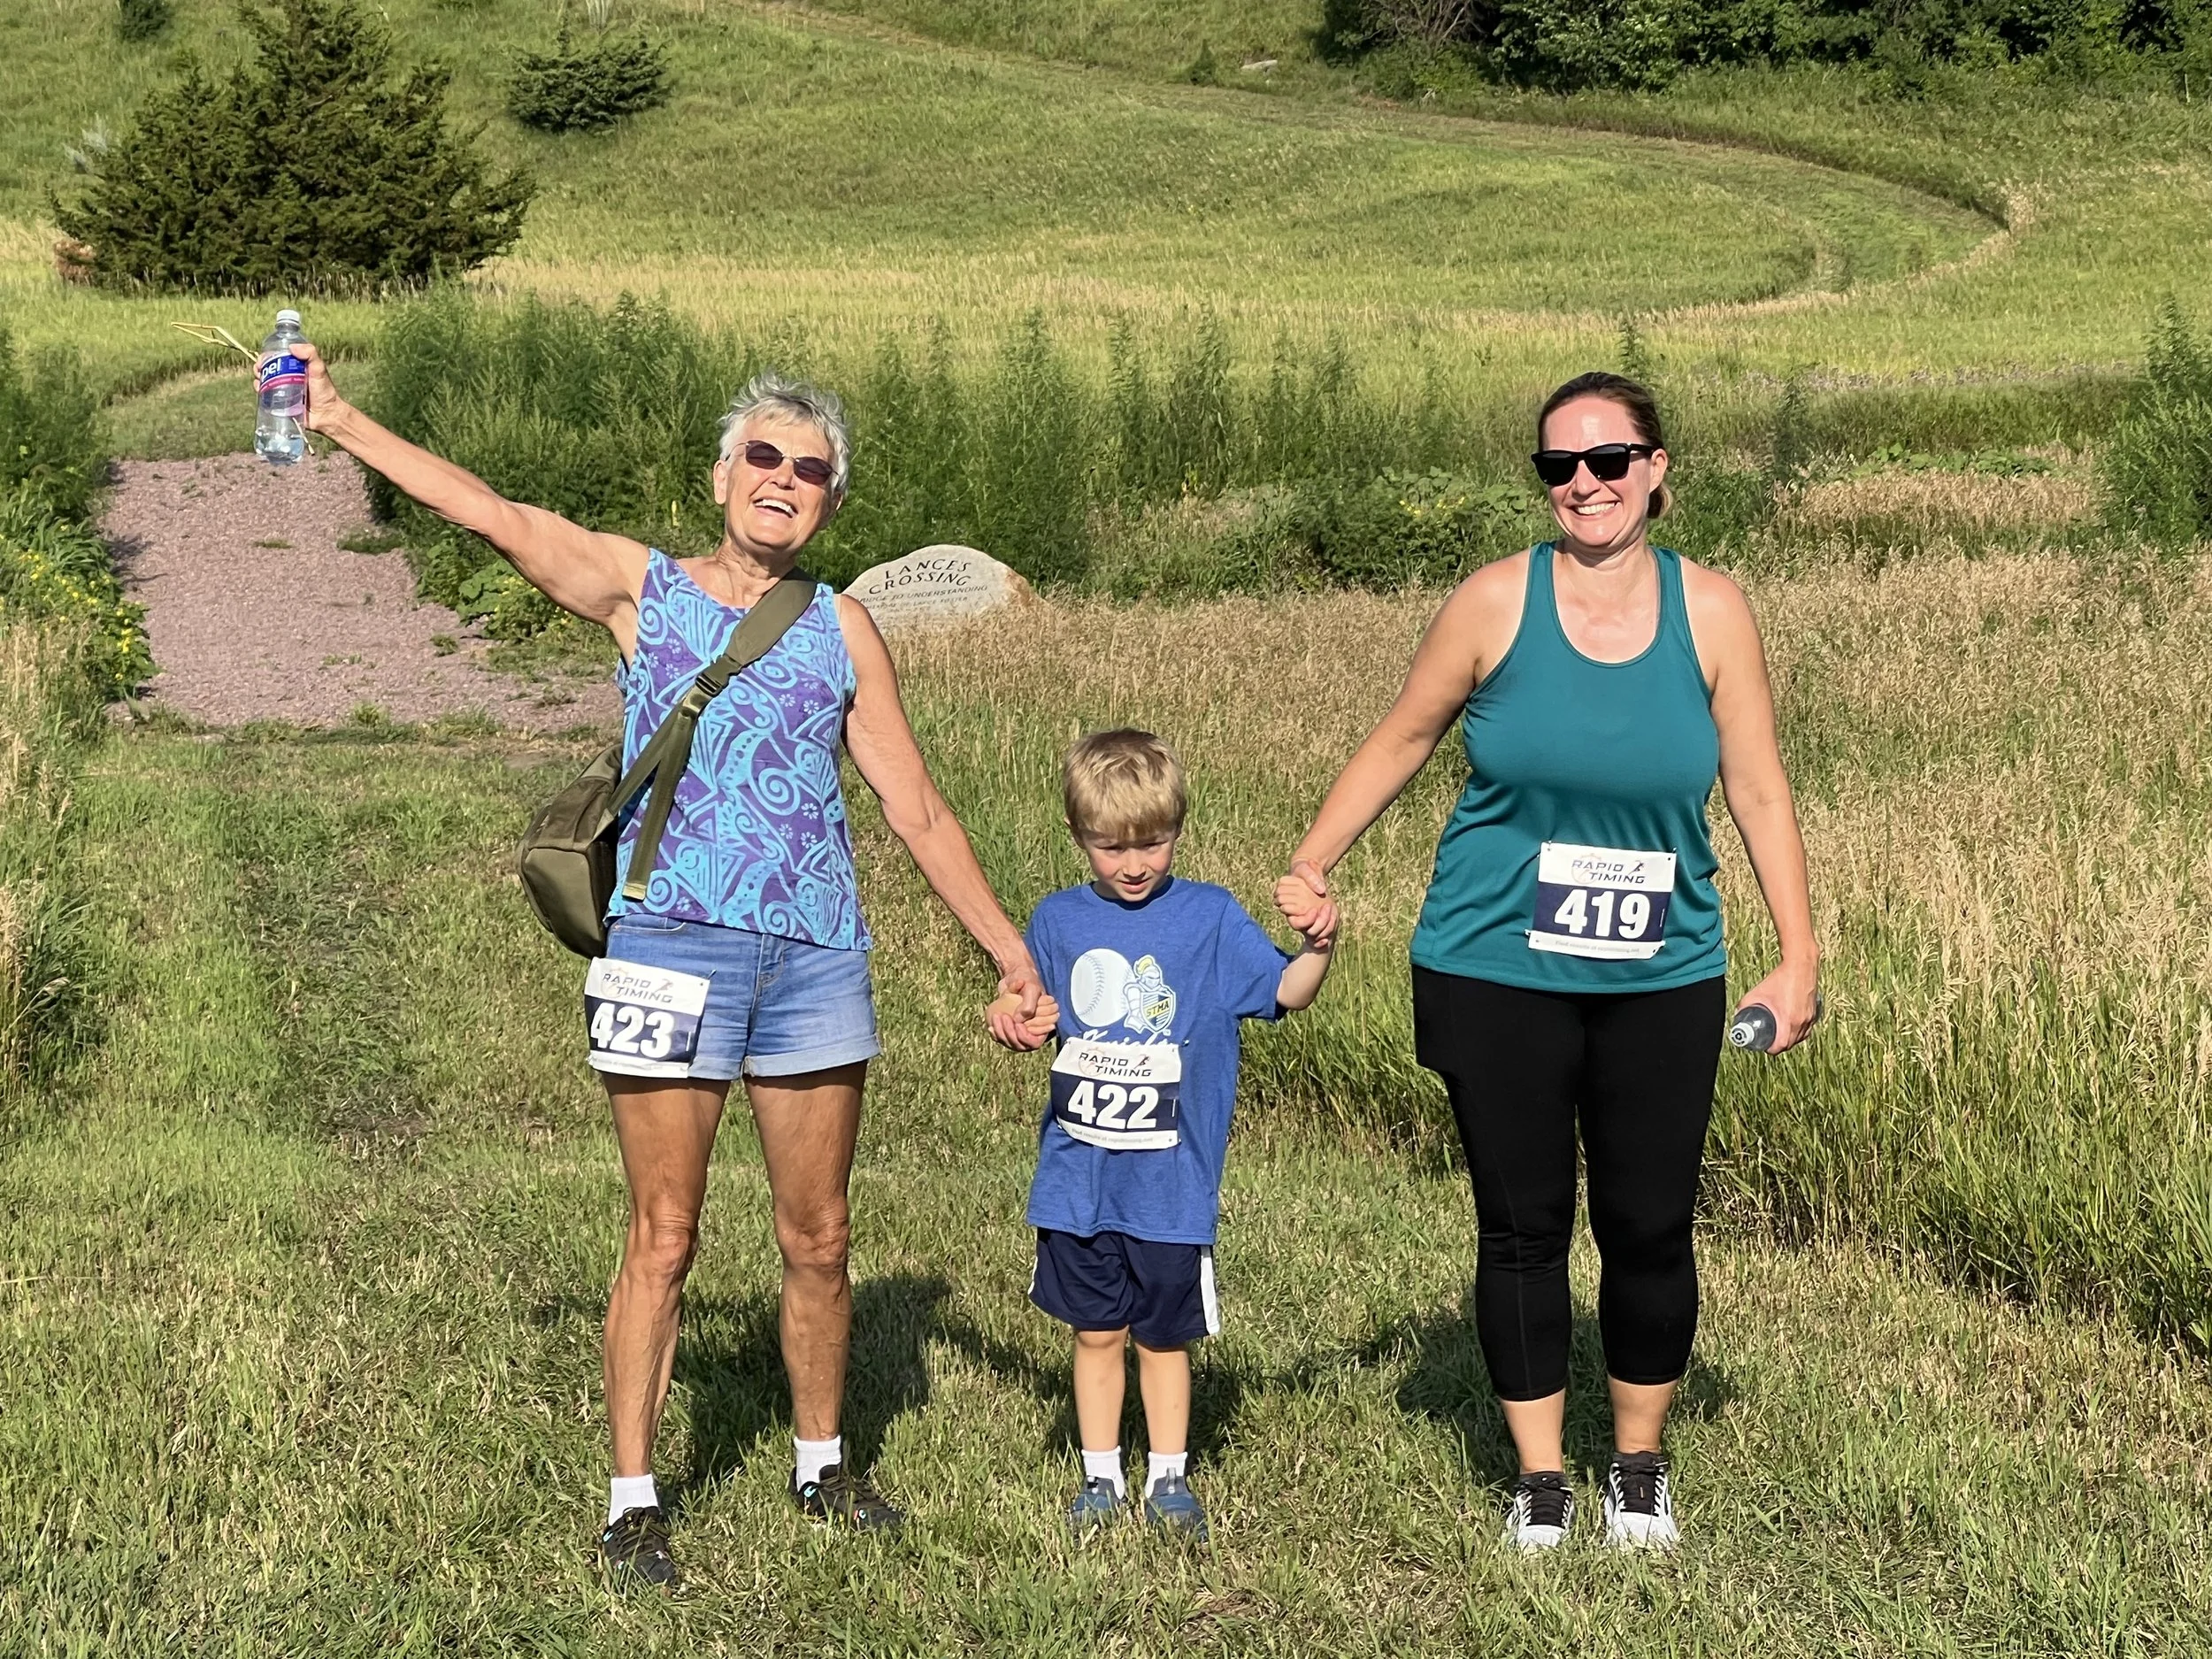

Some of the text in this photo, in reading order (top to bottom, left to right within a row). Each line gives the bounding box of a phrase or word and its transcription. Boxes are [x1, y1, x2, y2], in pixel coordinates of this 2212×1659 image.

[869, 572, 972, 595] CROSSING
[907, 586, 988, 599] UNDERSTANDING
[1571, 859, 1624, 872] RAPID
[1589, 872, 1646, 884] TIMING
[1554, 888, 1651, 940] 419
[602, 973, 651, 988] RAPID
[617, 986, 673, 1003] TIMING
[1146, 1000, 1170, 1018] STMA
[590, 1002, 675, 1058] 423
[1079, 1052, 1129, 1066] RAPID
[1094, 1065, 1152, 1077] TIMING
[1068, 1079, 1159, 1130] 422
